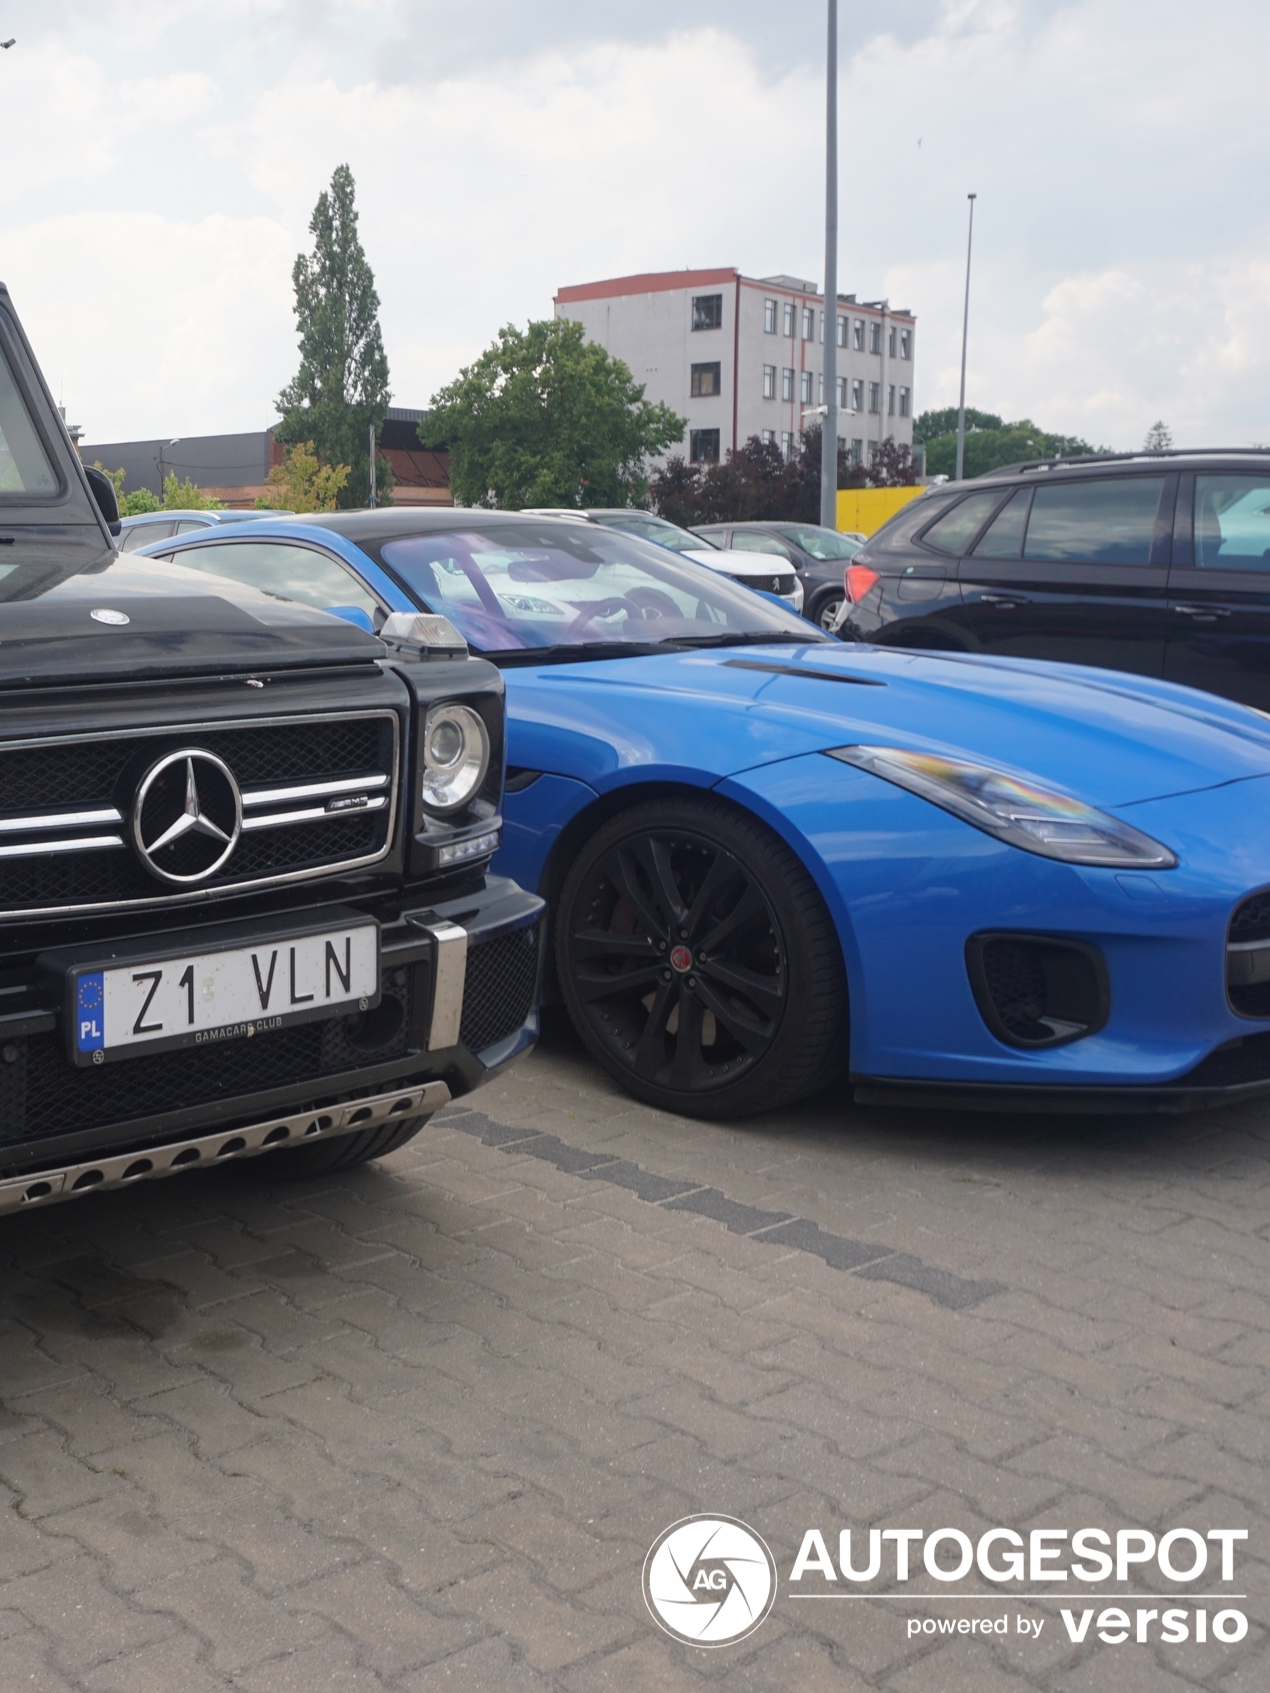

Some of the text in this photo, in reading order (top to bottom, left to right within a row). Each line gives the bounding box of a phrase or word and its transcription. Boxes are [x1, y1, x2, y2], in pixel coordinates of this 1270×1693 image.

[132, 936, 353, 1035] Z1 VLN
[81, 1020, 101, 1040] PL
[256, 1017, 282, 1030] CLUB
